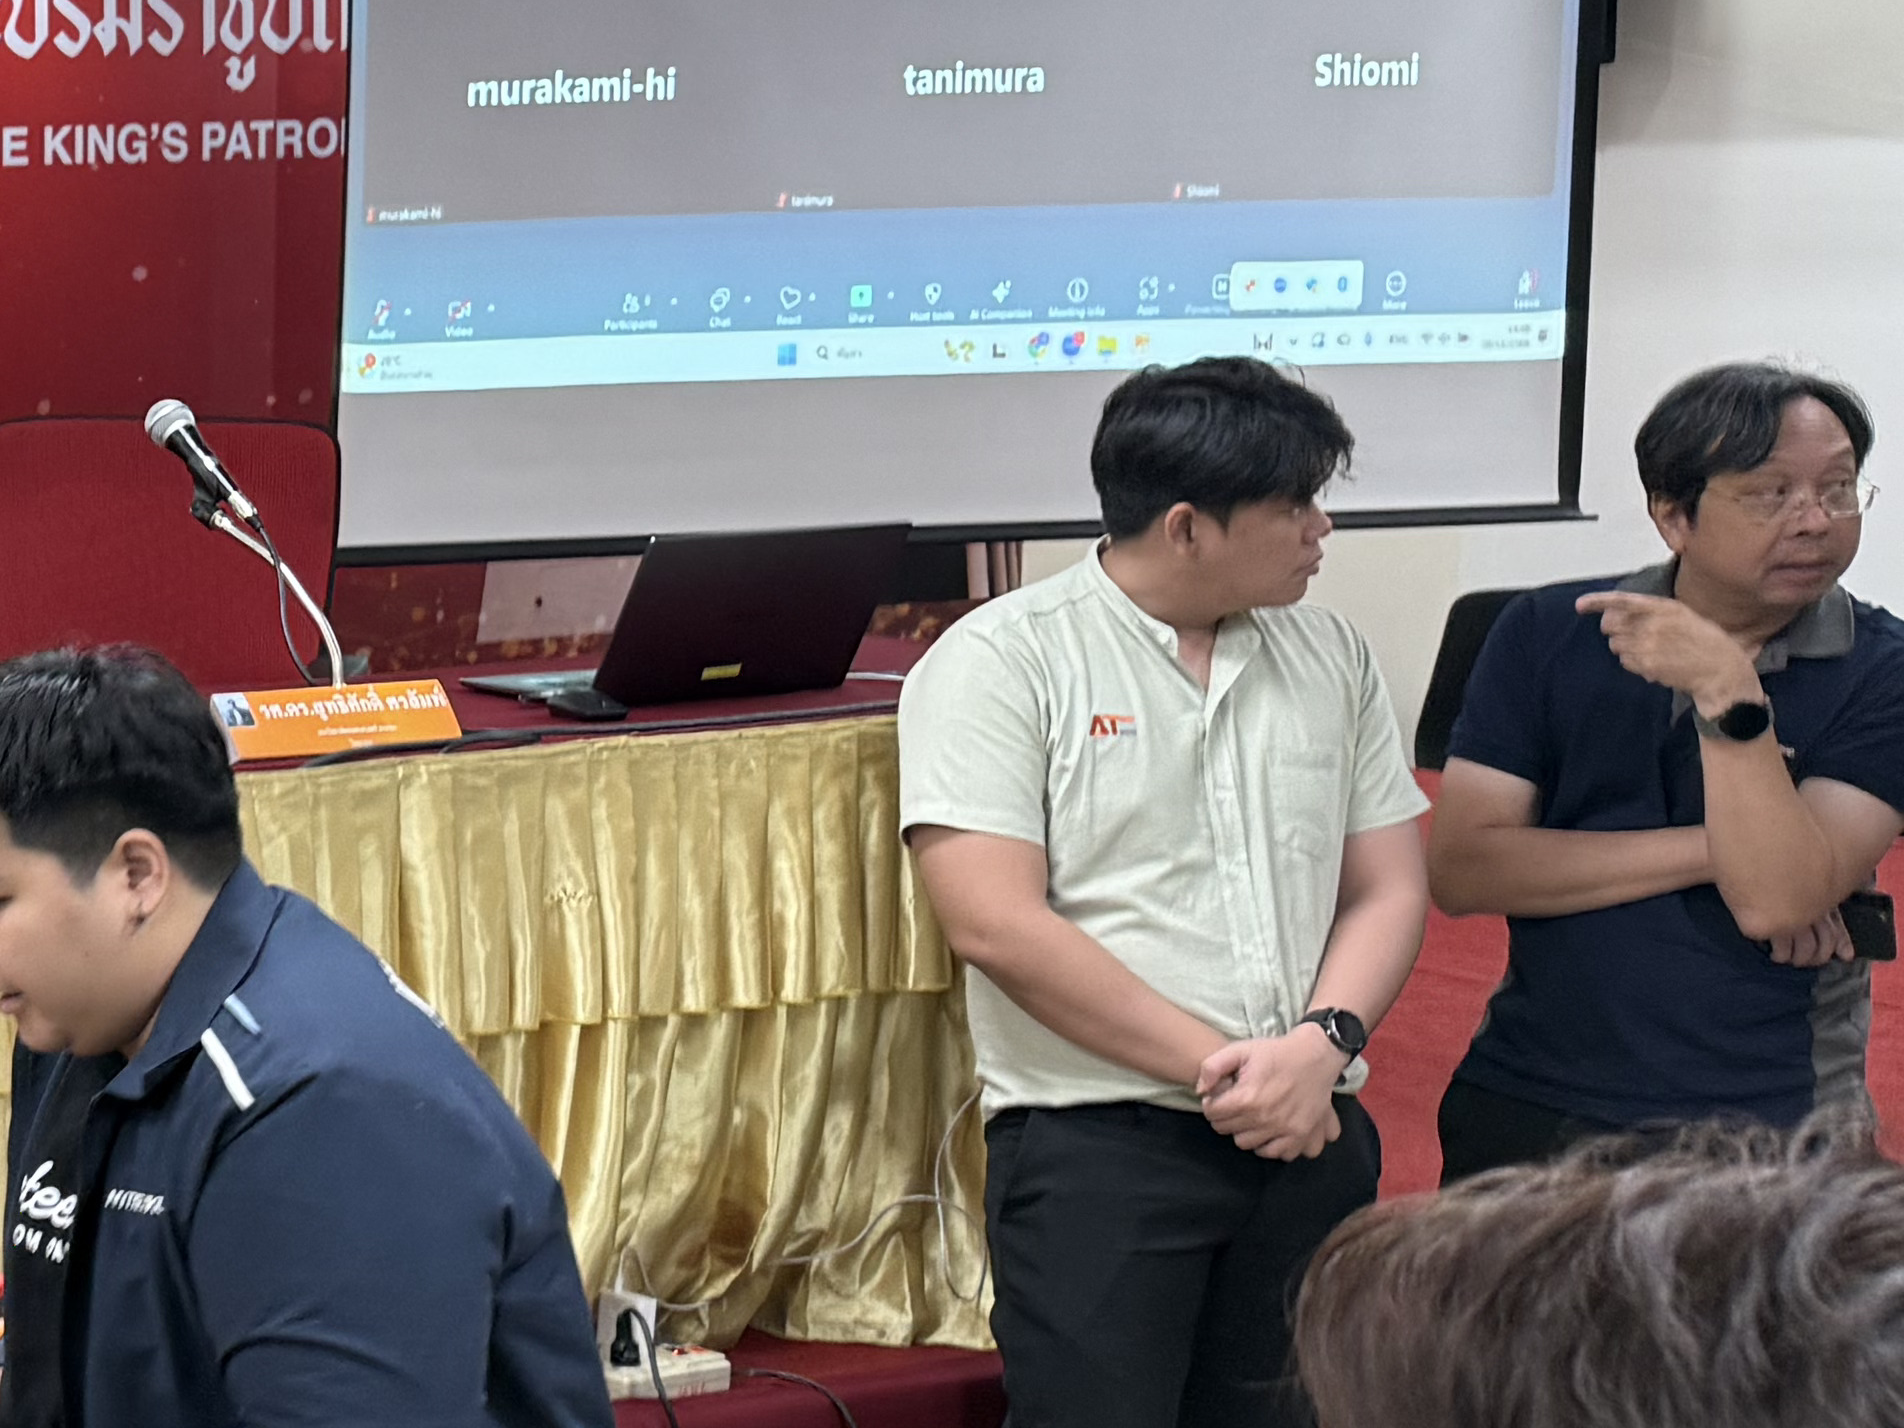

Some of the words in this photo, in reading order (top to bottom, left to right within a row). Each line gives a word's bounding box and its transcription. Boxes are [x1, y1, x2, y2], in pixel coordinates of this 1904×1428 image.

[467, 66, 677, 108] murakami-hi
[903, 61, 1045, 96] tanimura
[1315, 52, 1421, 88] Shiomi
[43, 121, 189, 166] KING'S
[201, 116, 345, 162] PATRO
